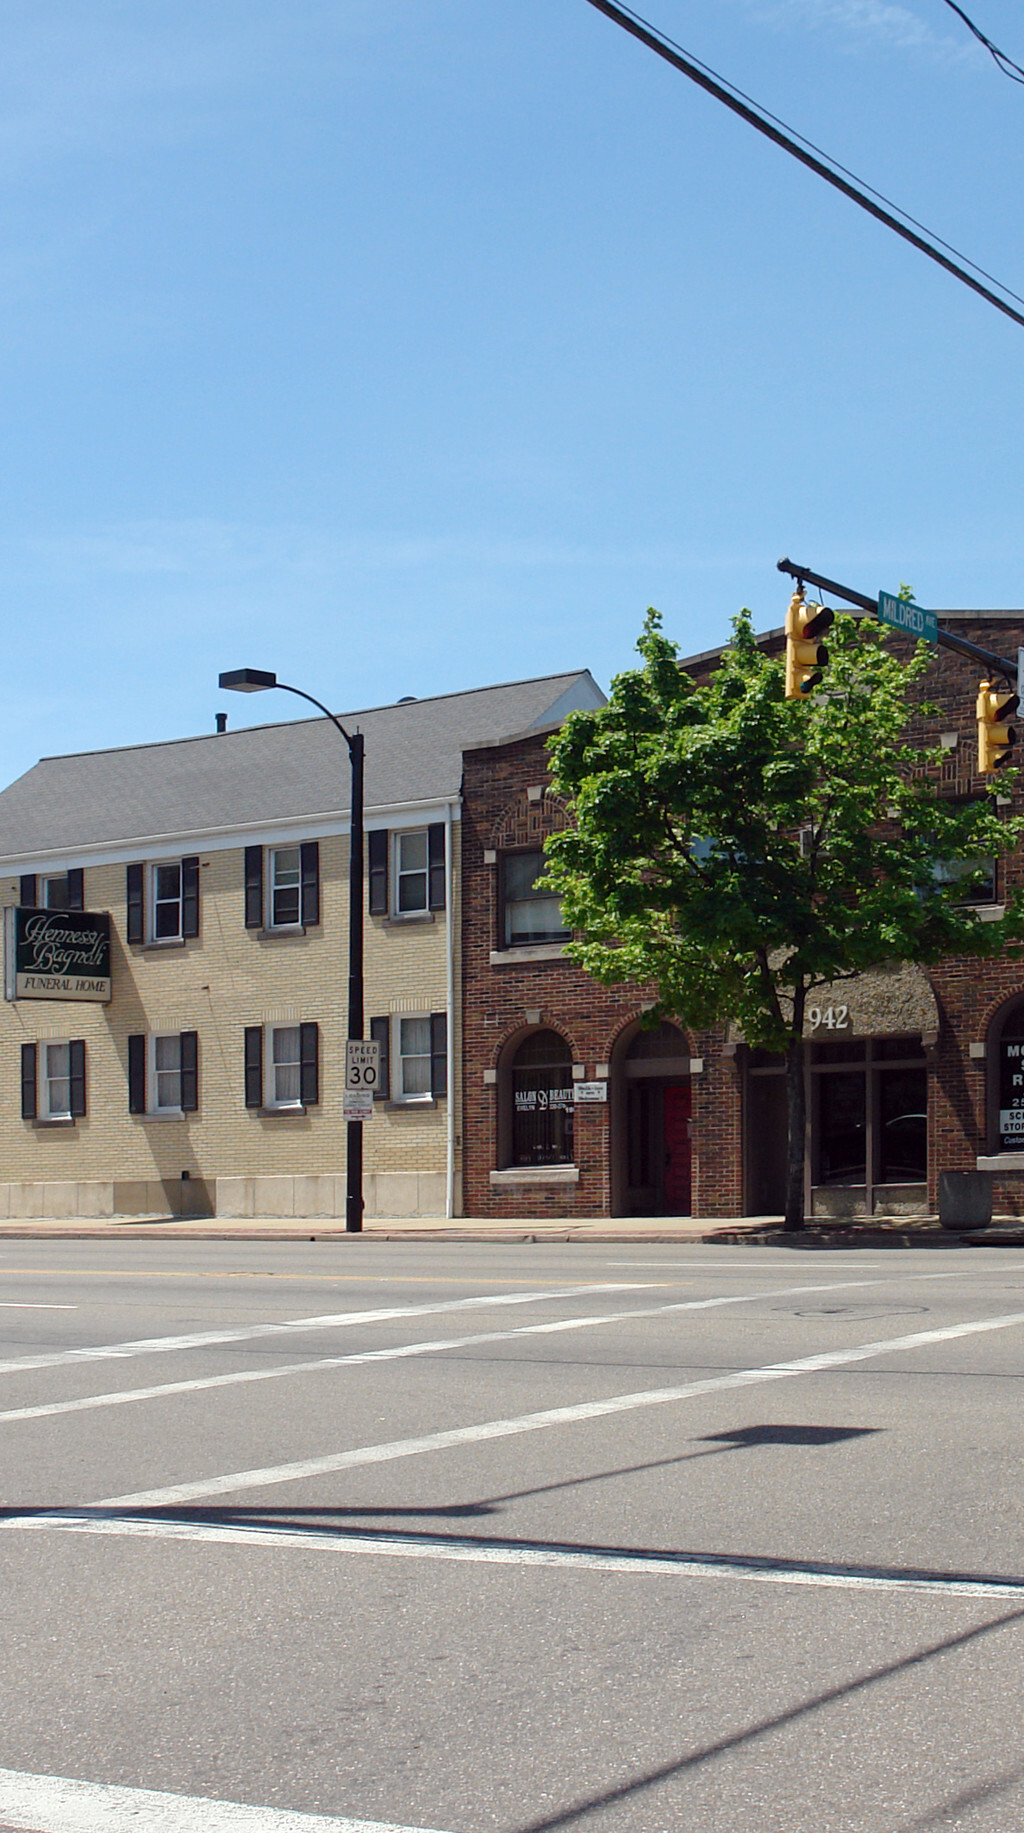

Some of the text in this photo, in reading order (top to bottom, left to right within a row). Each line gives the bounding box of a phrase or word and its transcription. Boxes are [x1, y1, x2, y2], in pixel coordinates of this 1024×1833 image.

[883, 596, 924, 632] MILDRED
[19, 914, 105, 954] Hennessy
[24, 941, 110, 975] Bagnoli
[24, 977, 106, 992] FUNERAL HOME
[808, 1005, 849, 1031] 942
[349, 1046, 378, 1055] SPEED
[351, 1056, 374, 1065] LIMIT
[350, 1066, 377, 1085] 30
[515, 1091, 537, 1101] SALON
